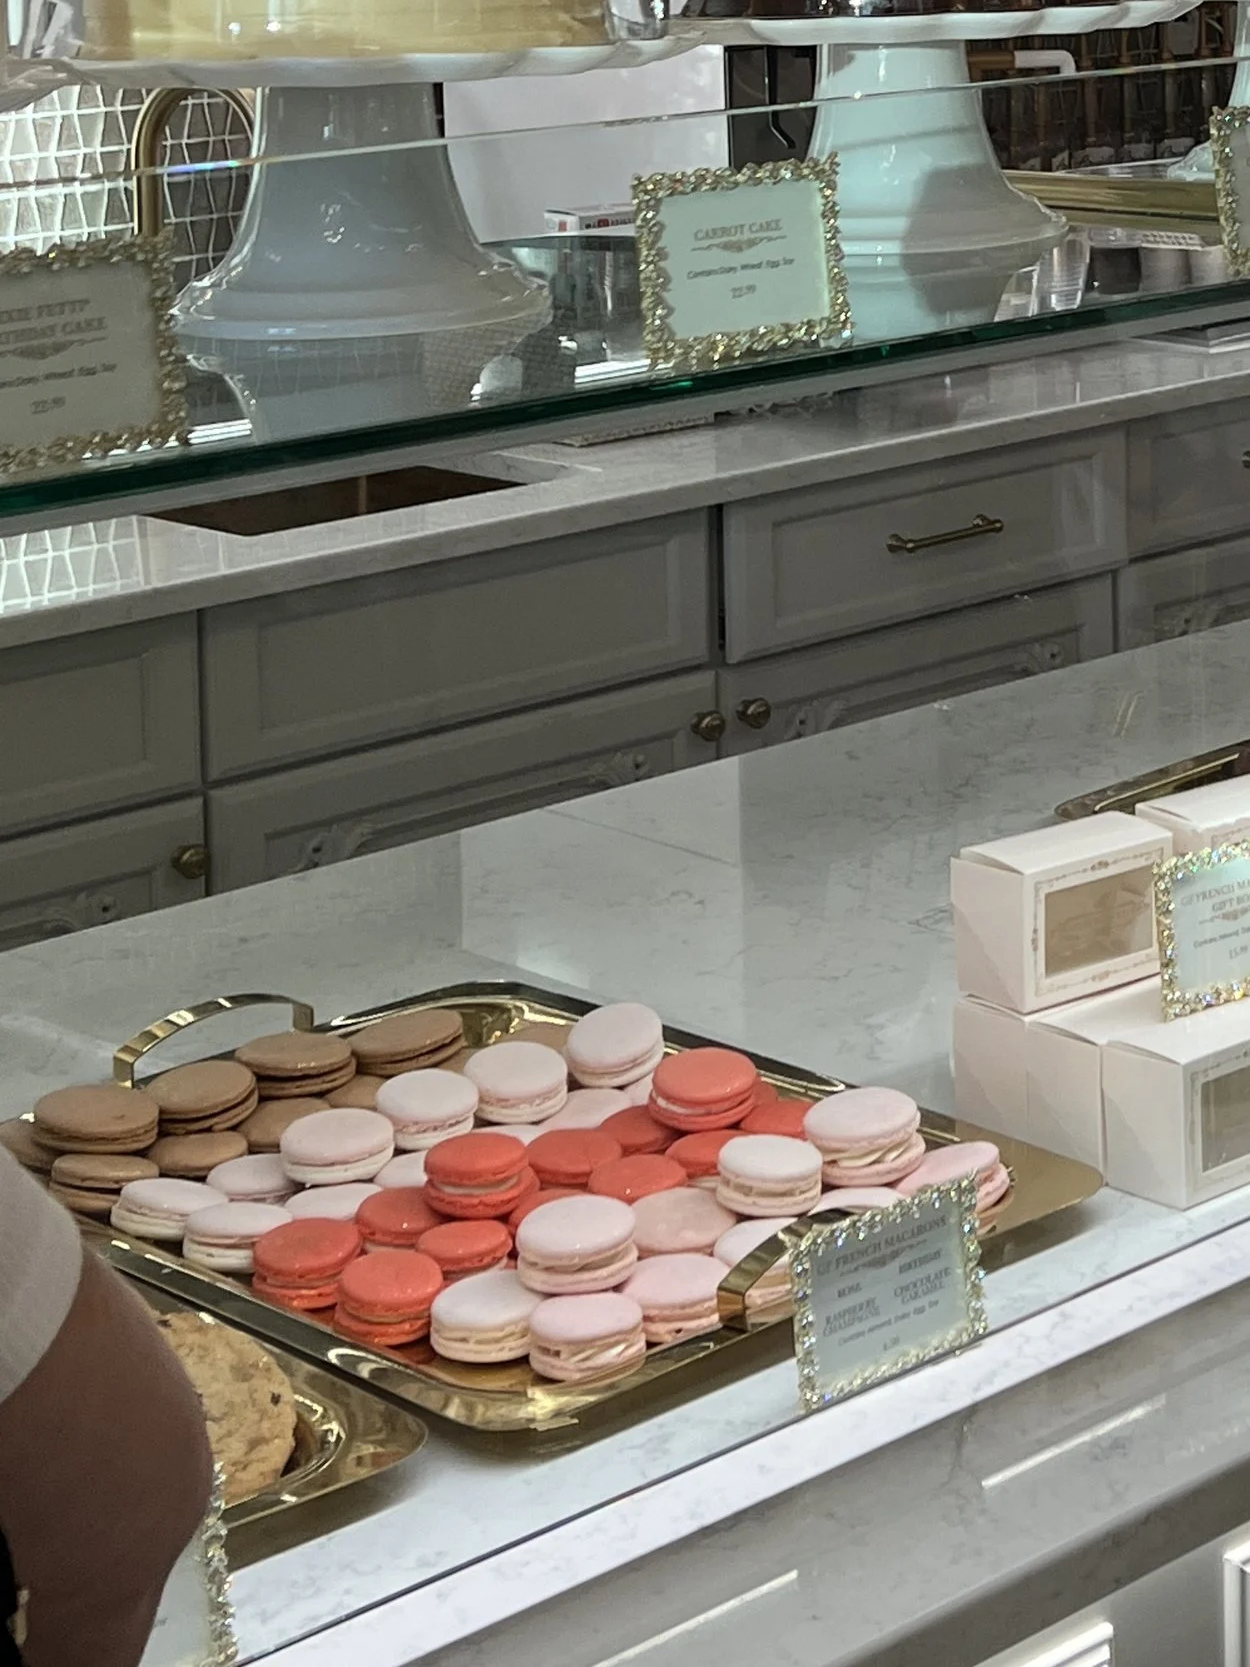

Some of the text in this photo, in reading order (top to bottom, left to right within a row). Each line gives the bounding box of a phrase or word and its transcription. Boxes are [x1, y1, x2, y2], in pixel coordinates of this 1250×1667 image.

[694, 218, 783, 240] CARROT CAKE
[61, 316, 108, 334] CAKE
[1195, 883, 1234, 902] FRENCH
[1211, 896, 1234, 912] GIFT
[835, 1241, 881, 1269] FRENCH
[884, 1214, 946, 1247] MACARONS
[894, 1266, 951, 1297] CHOCOLATE
